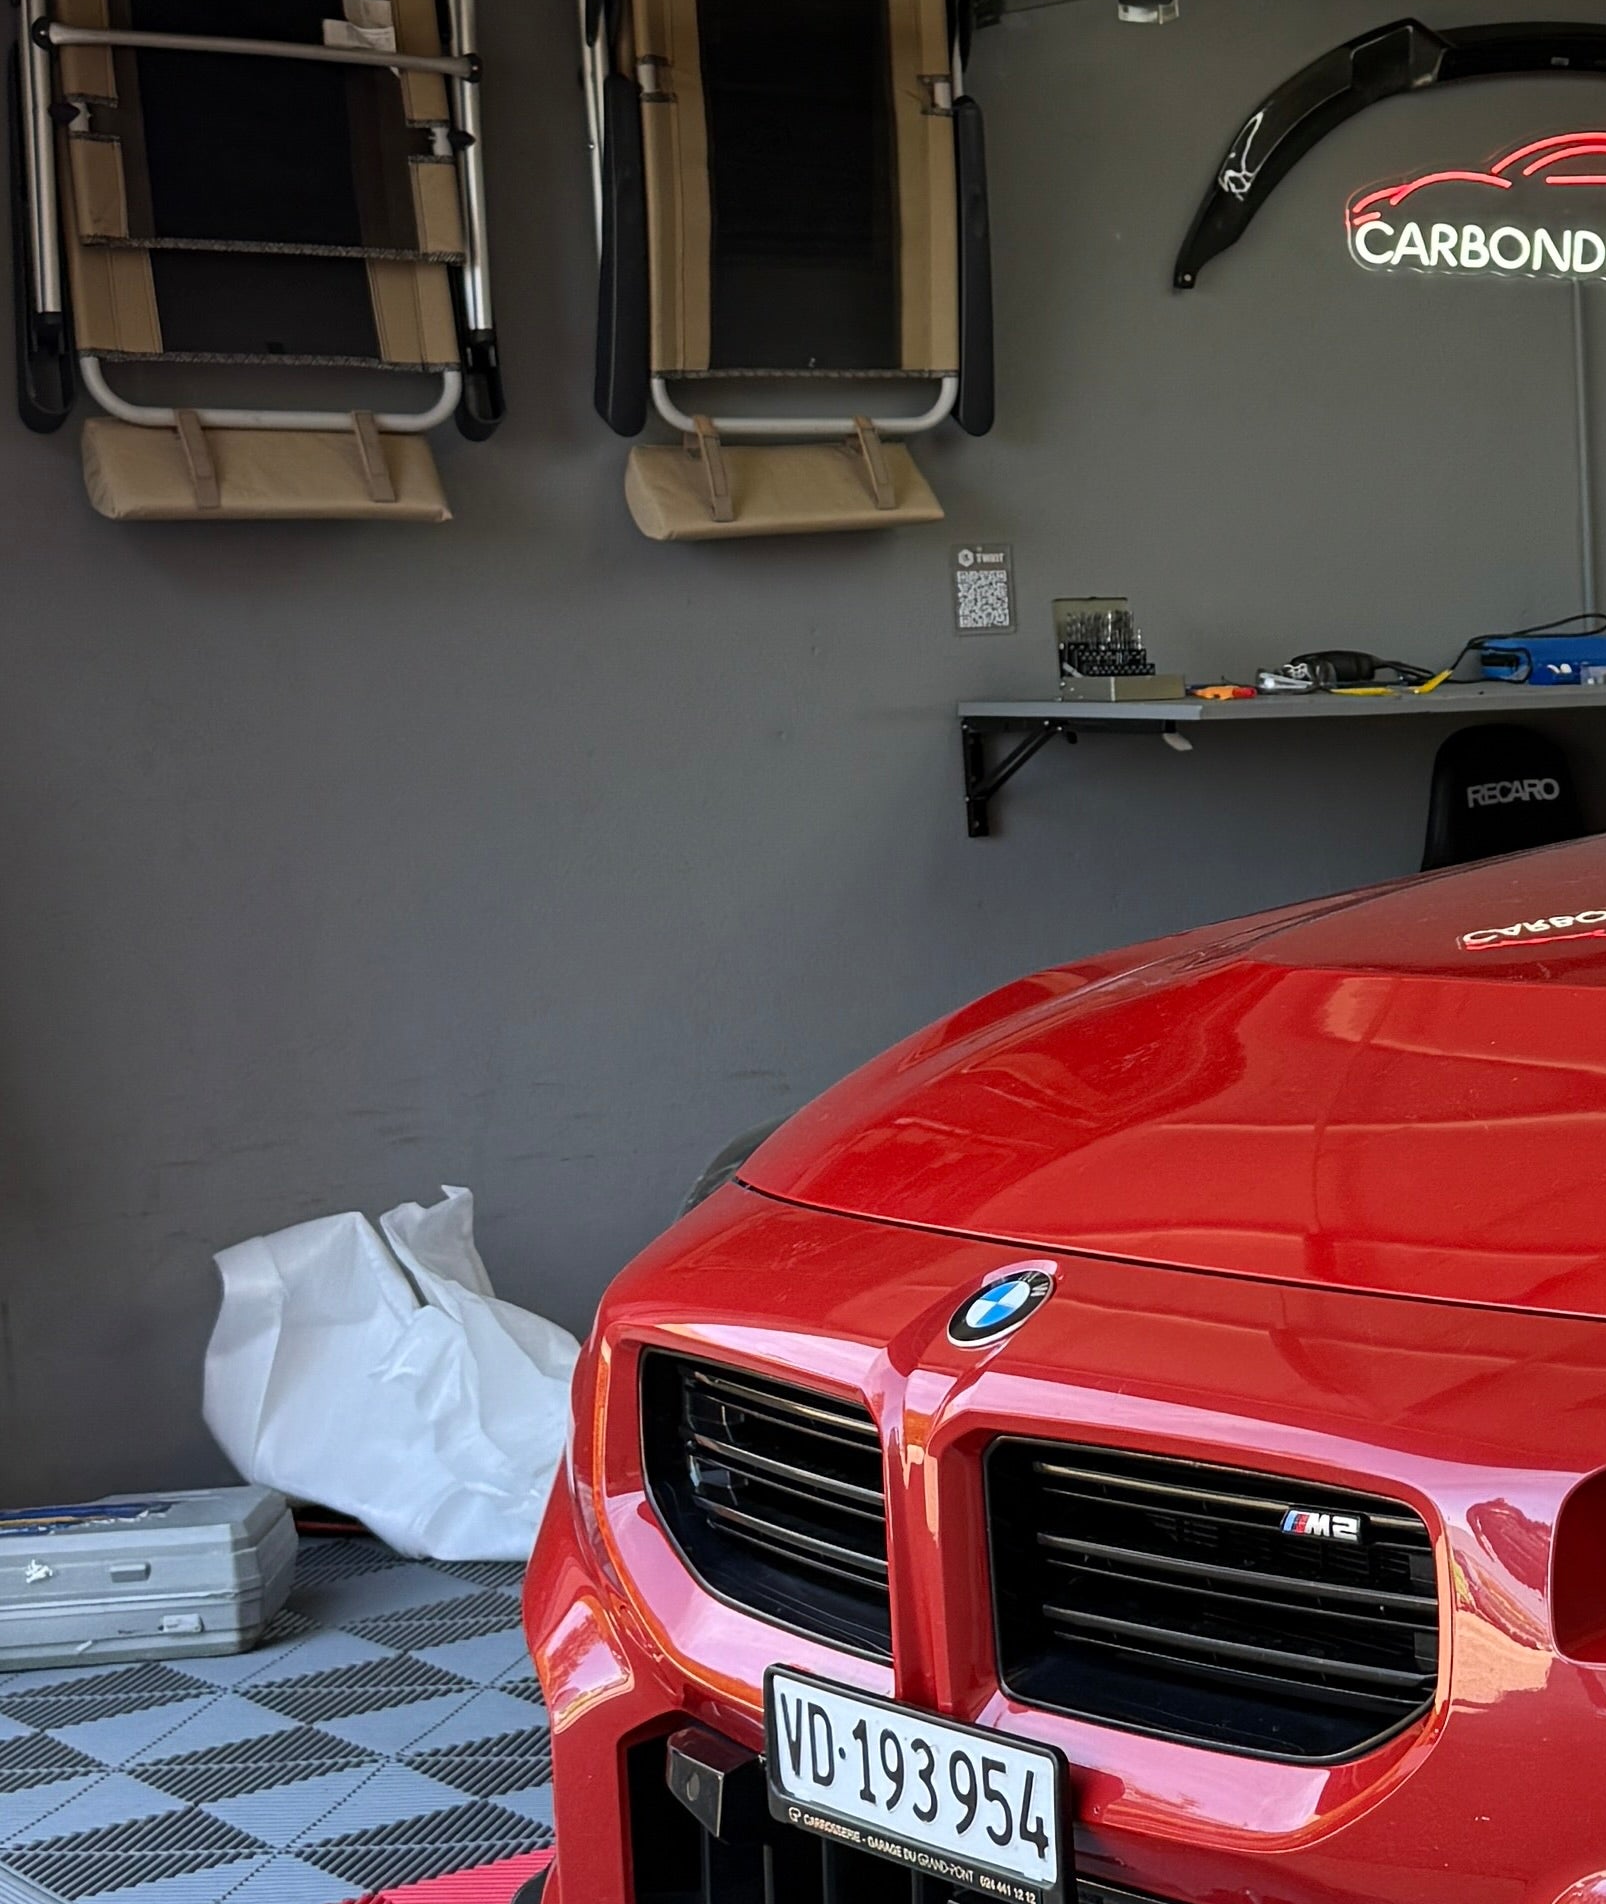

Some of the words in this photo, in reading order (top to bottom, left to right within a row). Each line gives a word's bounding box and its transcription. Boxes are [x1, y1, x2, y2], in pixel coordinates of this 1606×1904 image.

[1466, 778, 1560, 808] RECARO
[1304, 1511, 1358, 1542] M2
[804, 1814, 861, 1843] CARROSSERIE
[867, 1835, 902, 1858] GARAGE
[903, 1847, 917, 1863] DU
